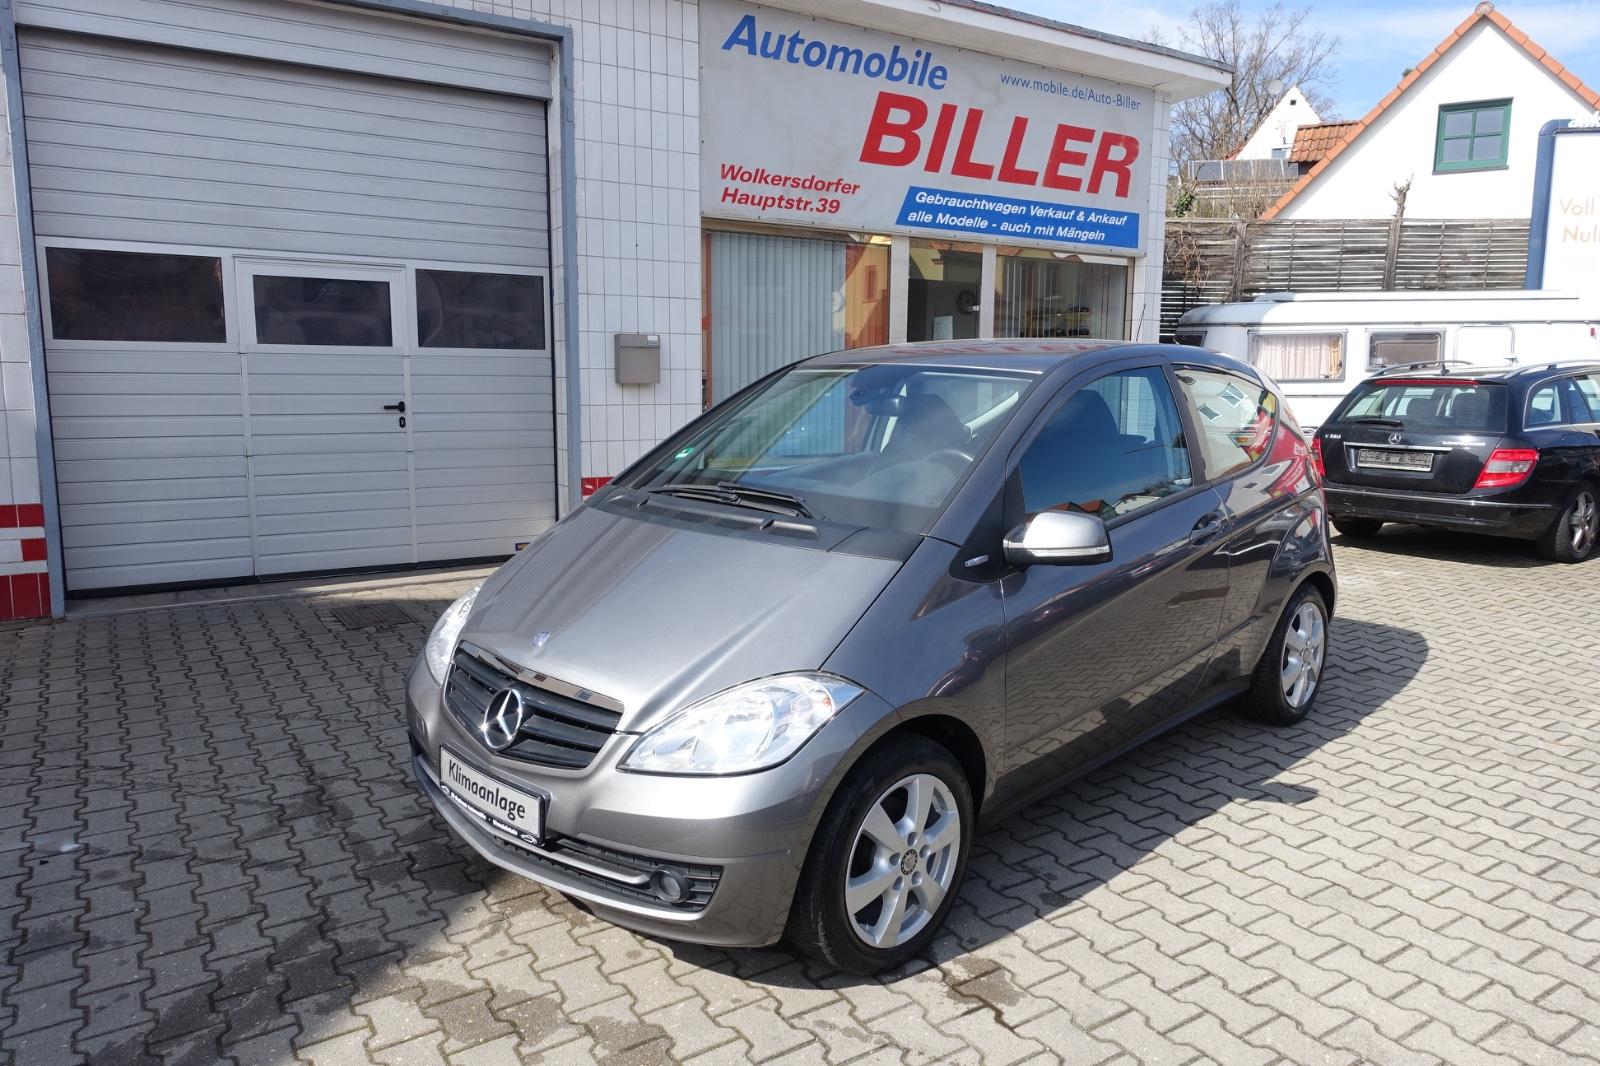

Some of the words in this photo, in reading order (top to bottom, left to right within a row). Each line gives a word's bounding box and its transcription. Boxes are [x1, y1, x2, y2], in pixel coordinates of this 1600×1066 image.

[722, 14, 947, 90] Automobile
[1000, 73, 1141, 111] www.mobile.de/Auto-Biller
[859, 91, 1140, 198] BILLER
[720, 163, 860, 195] Wolkersdorfer
[721, 187, 841, 213] Hauptstr.39
[915, 191, 1026, 215] Gebrauchtwagen
[1030, 205, 1075, 221] Verkauf
[1076, 211, 1085, 221] &
[1087, 212, 1128, 226] Ankauf
[1560, 197, 1595, 217] Voll
[907, 211, 932, 223] alle
[936, 212, 988, 229] Modelle
[1000, 221, 1031, 234] auch
[1033, 224, 1054, 236] mit
[1056, 227, 1105, 242] Mängeln
[1563, 224, 1600, 244] Nul
[448, 759, 526, 820] Klimaanlage
